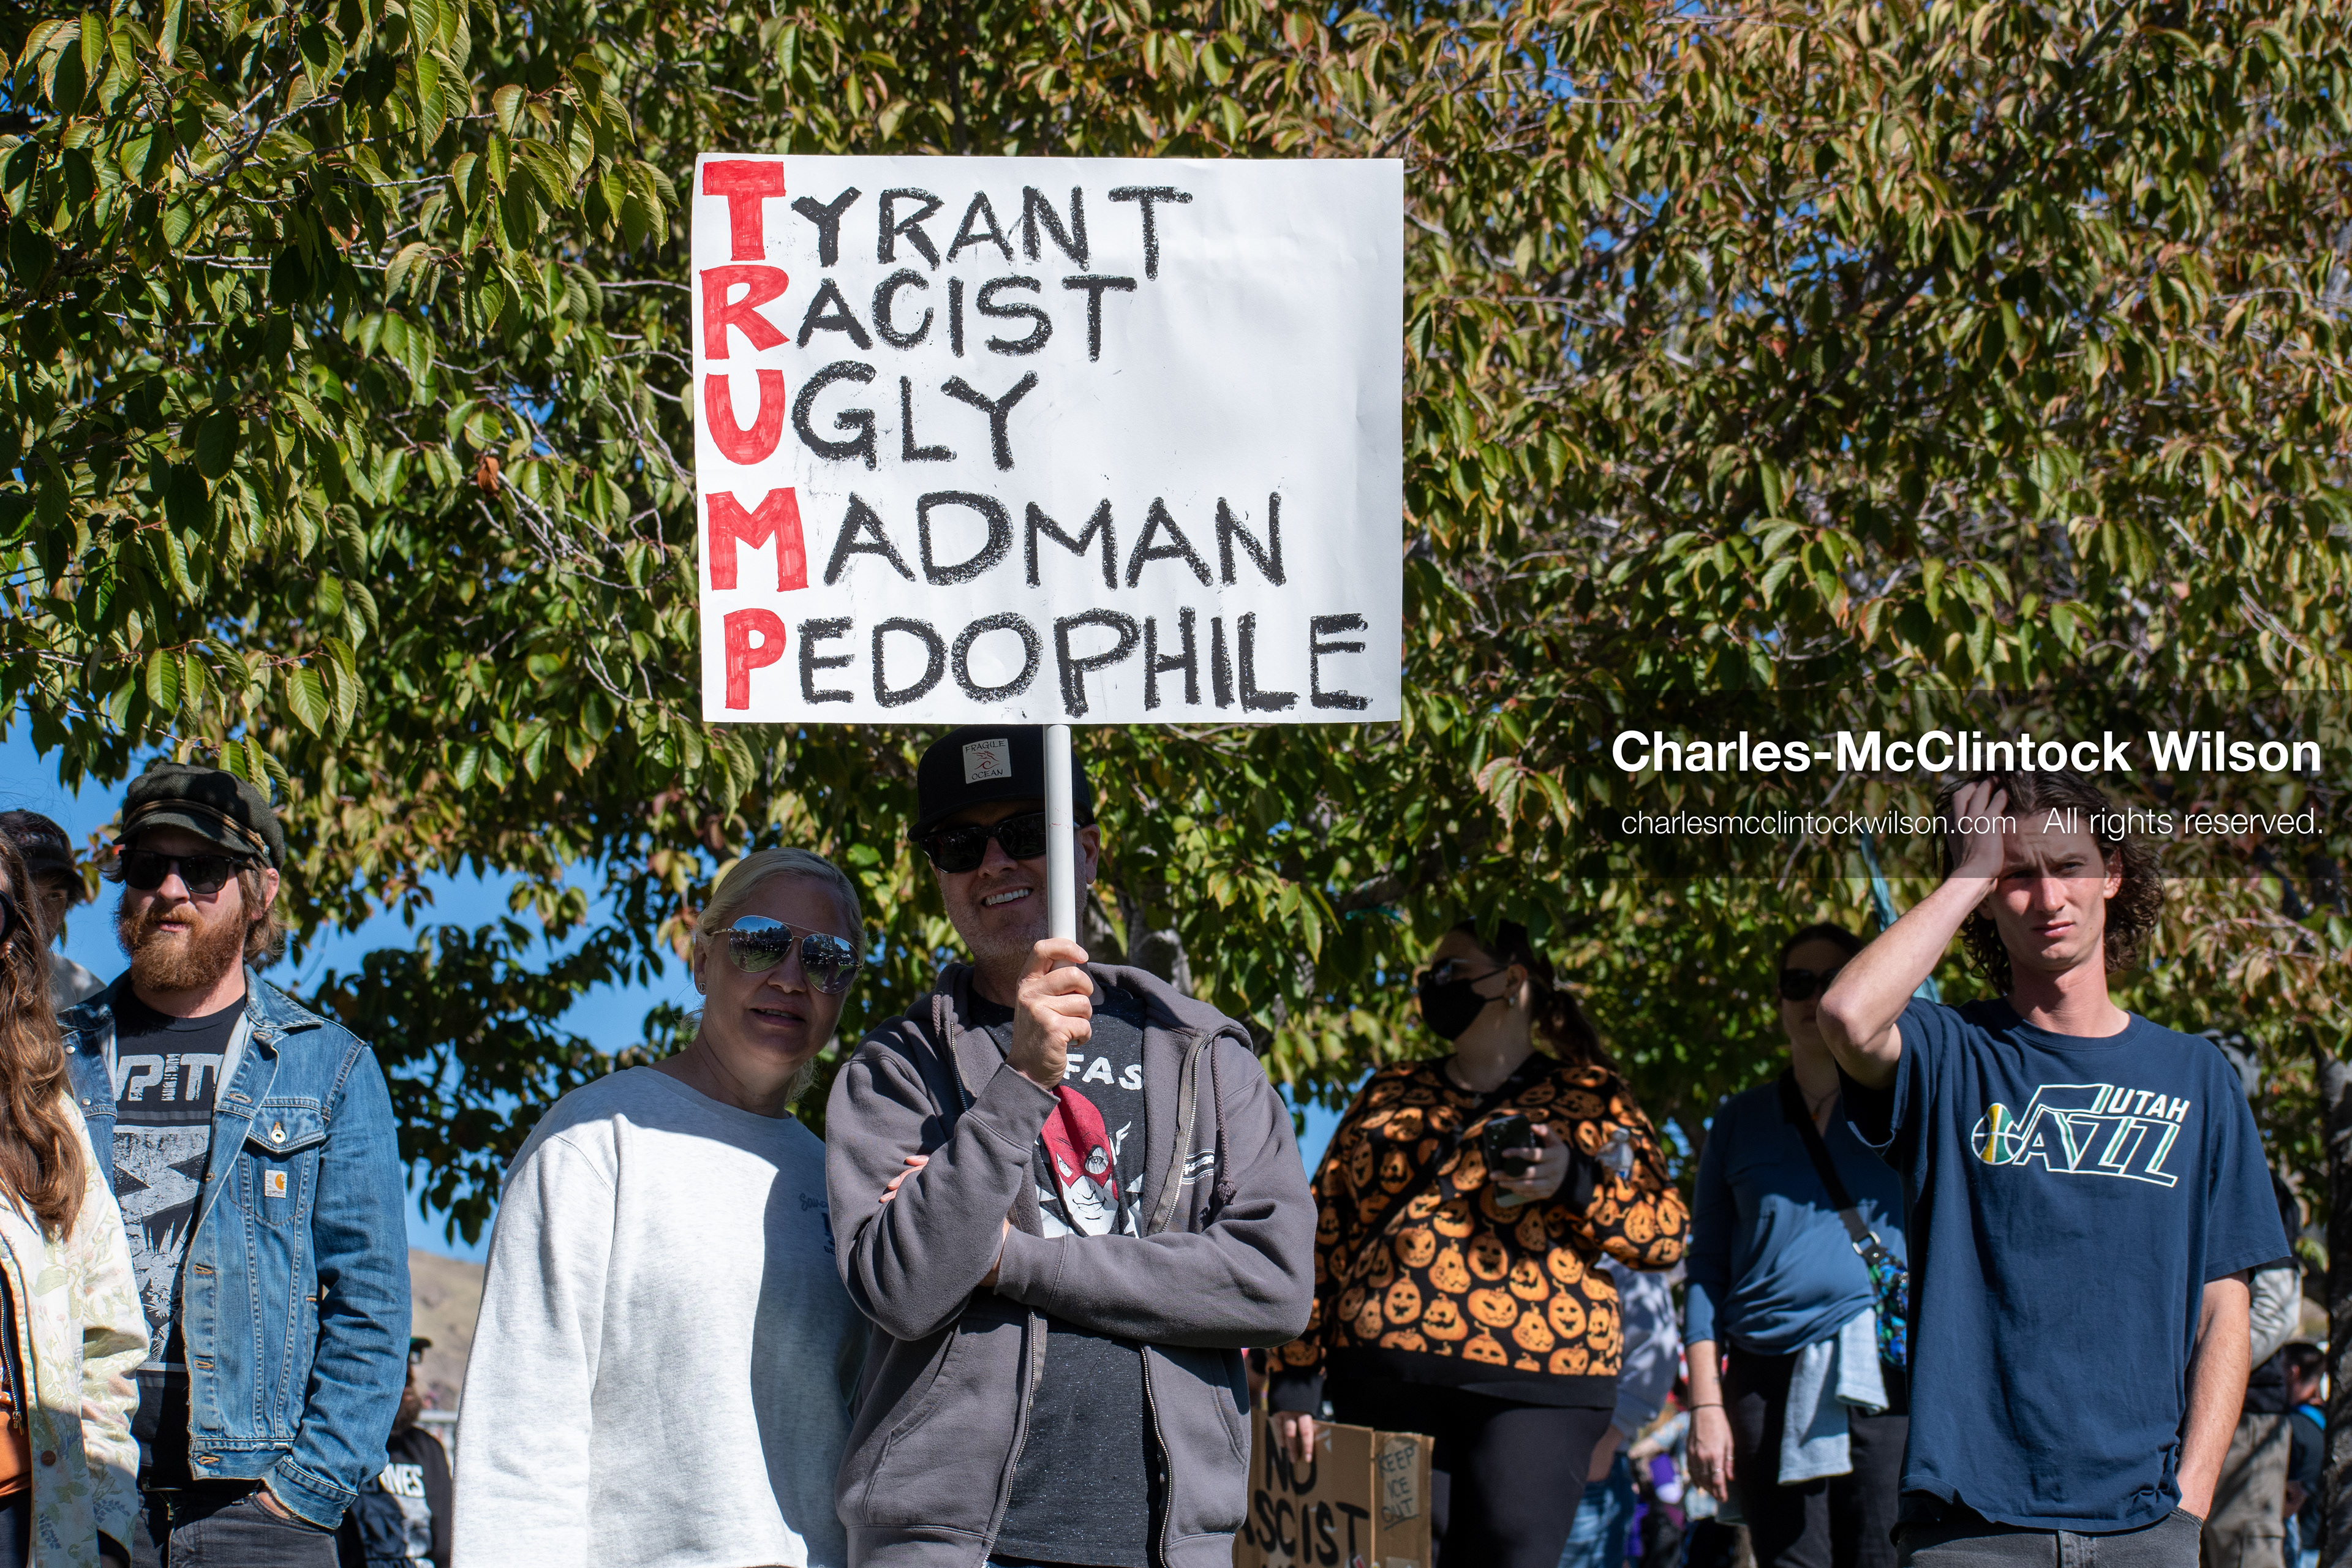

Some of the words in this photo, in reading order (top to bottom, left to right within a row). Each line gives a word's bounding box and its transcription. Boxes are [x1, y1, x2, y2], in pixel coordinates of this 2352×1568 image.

[702, 160, 1193, 280] TYRANT
[699, 265, 1137, 363] RACIST
[703, 360, 1038, 472] UGLY
[705, 487, 1286, 592] MADMAN
[724, 606, 1373, 718] PEDOPHILE
[965, 740, 1006, 754] FRAGILE
[971, 769, 1003, 780] OCEAN
[2107, 1087, 2190, 1123] UTAH
[1265, 1418, 1317, 1495] NO
[1376, 1446, 1415, 1479] KEEP
[1381, 1497, 1412, 1524] OUT
[1387, 1476, 1411, 1498] ICE
